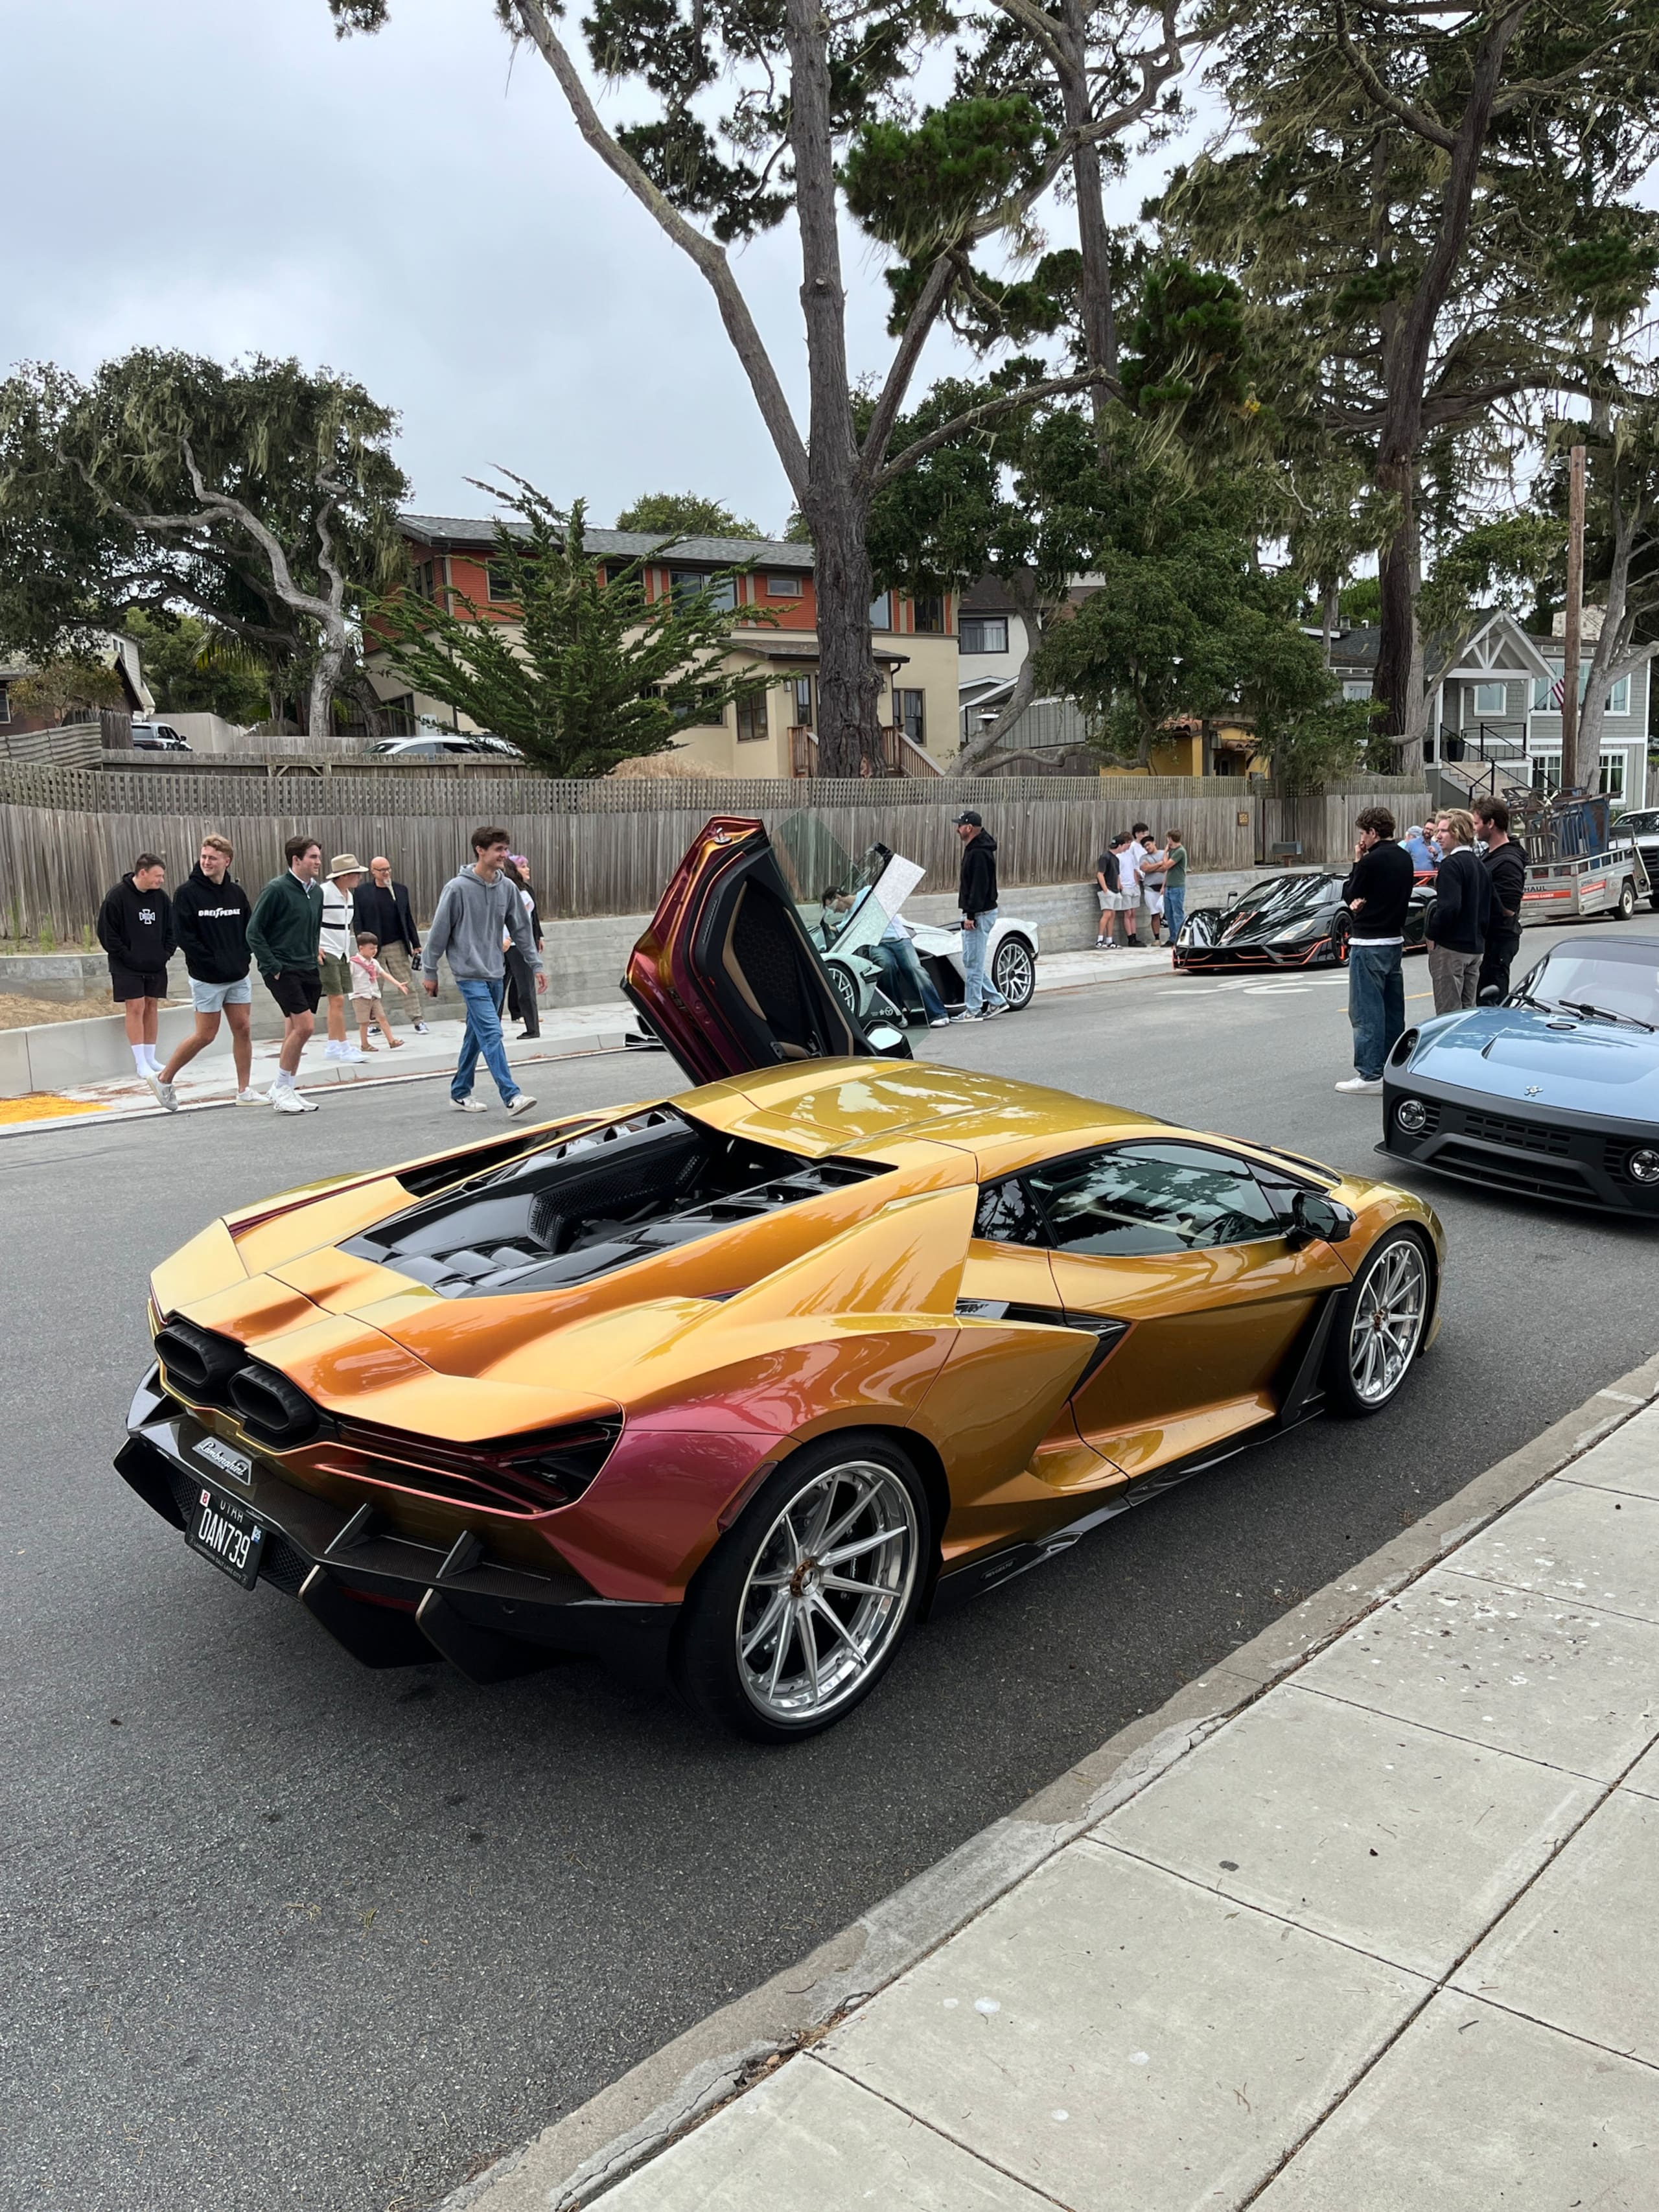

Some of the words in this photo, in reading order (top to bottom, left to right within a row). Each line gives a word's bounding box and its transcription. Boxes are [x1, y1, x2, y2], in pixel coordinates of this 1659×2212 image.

[197, 1441, 246, 1476] Lamborghini
[202, 1493, 208, 1504] 8
[220, 1500, 244, 1523] UTAH
